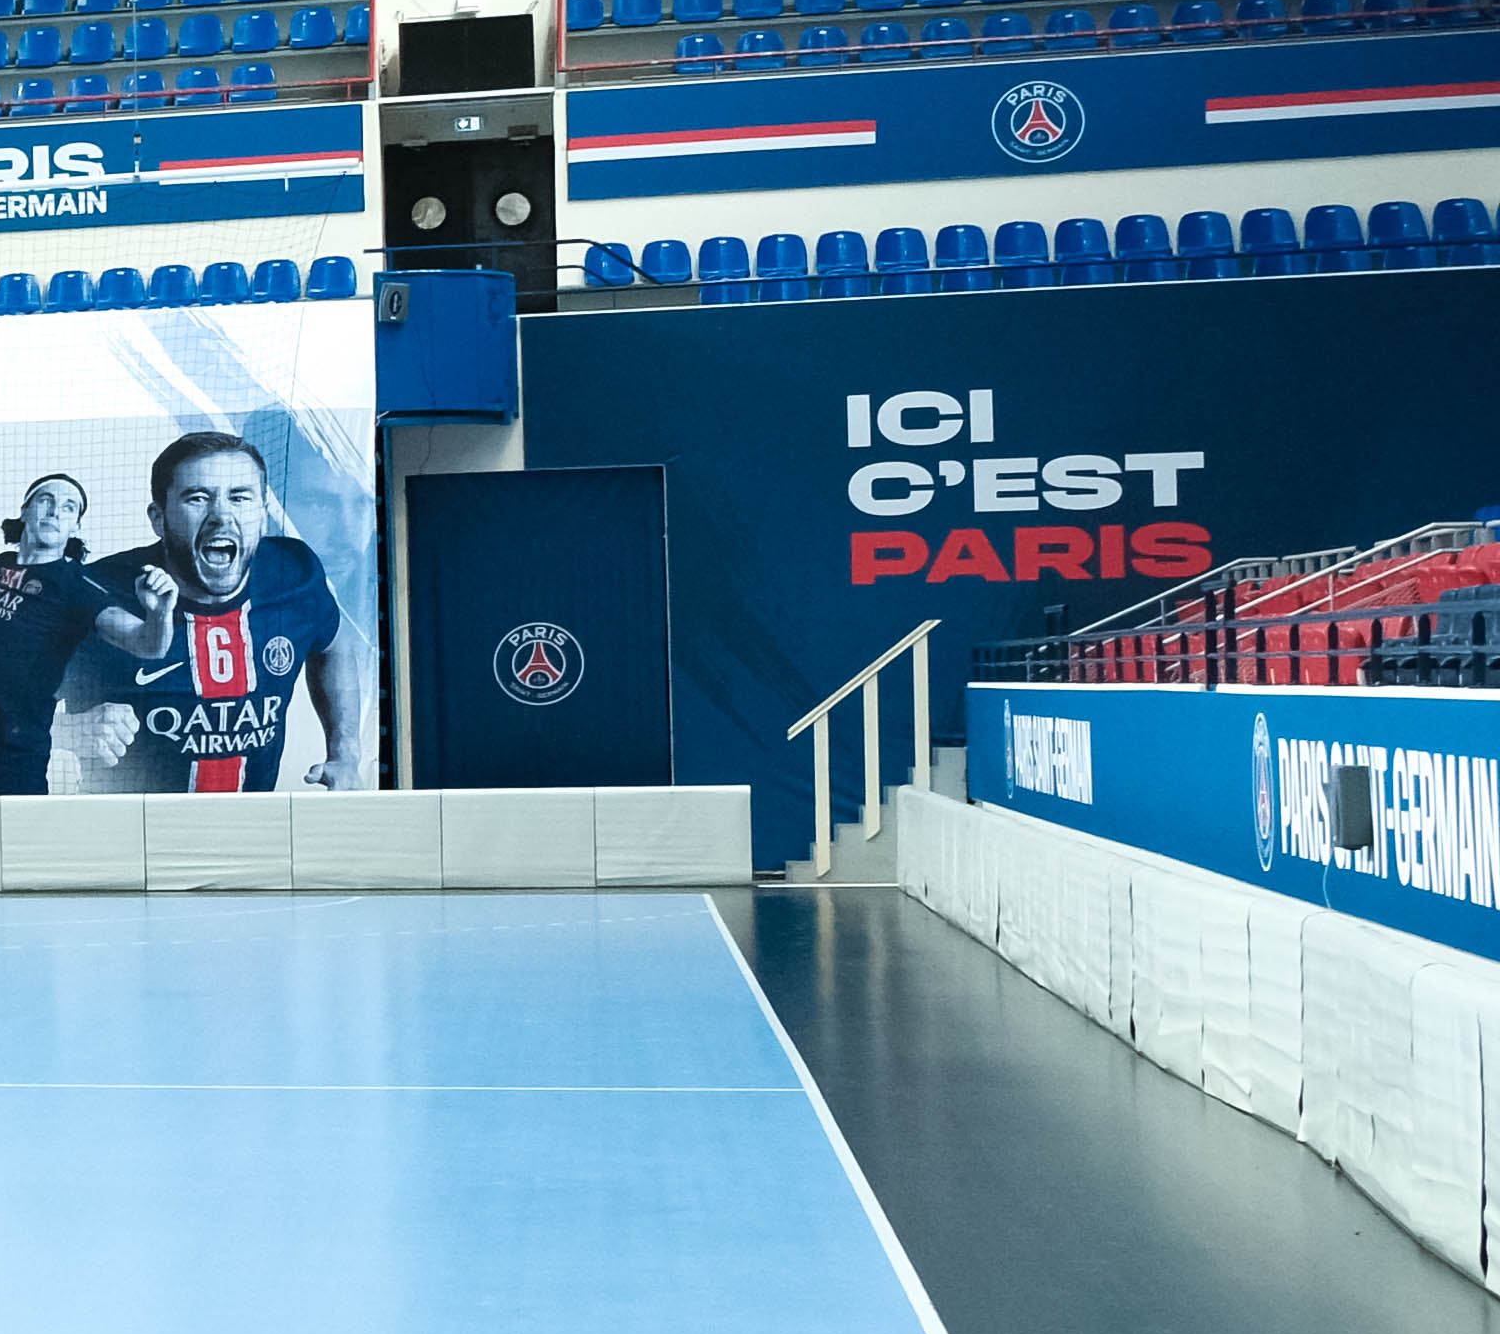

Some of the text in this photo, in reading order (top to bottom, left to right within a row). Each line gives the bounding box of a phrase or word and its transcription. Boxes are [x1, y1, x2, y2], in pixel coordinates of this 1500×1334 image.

[1006, 85, 1067, 106] PARIS
[846, 388, 994, 448] ICI
[847, 451, 1205, 516] C'EST
[850, 521, 1213, 585] PARIS
[206, 626, 234, 684] 6
[508, 627, 569, 647] PARIS
[146, 696, 282, 742] QATAR
[181, 725, 276, 754] AIRWAYS
[1278, 738, 1331, 866] PARIS
